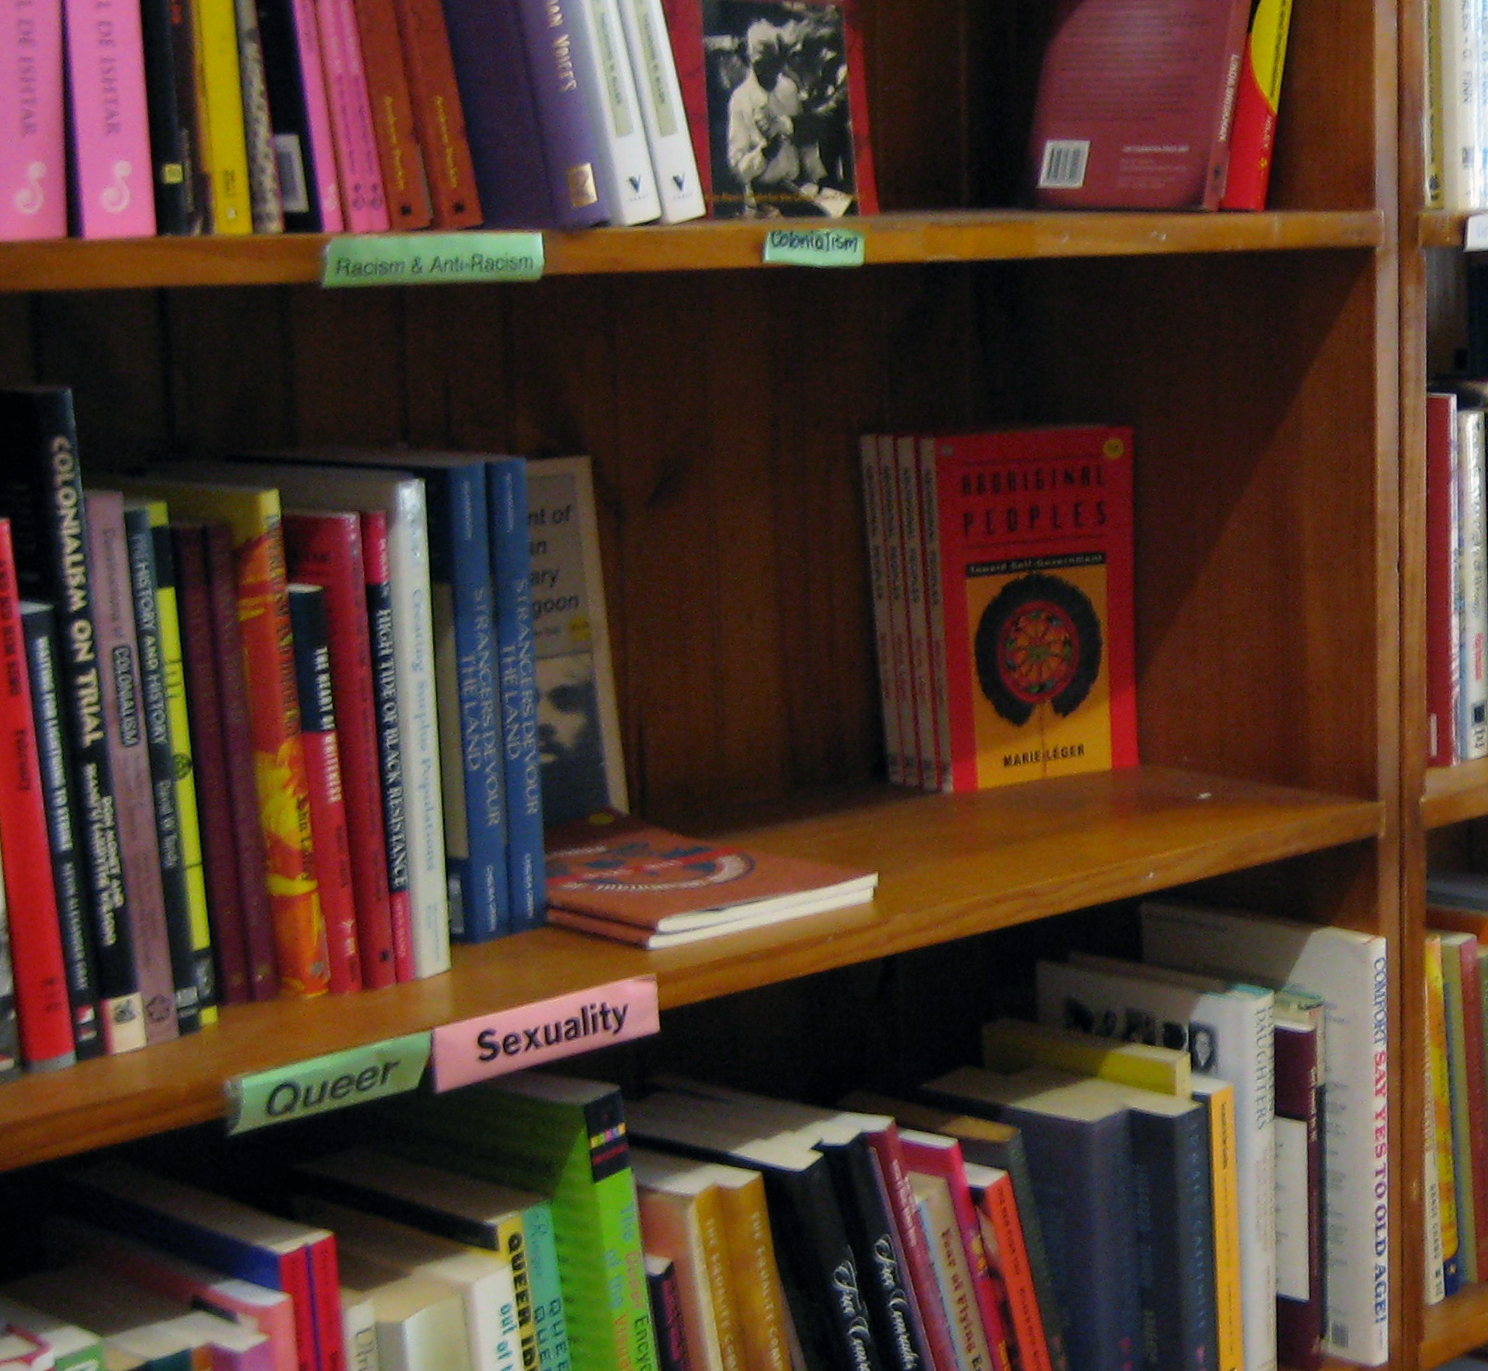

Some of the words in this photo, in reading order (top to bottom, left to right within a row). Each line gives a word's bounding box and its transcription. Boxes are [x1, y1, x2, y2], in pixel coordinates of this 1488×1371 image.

[17, 19, 36, 46] DE
[97, 20, 116, 46] DE
[19, 56, 37, 137] ISHTAR
[100, 57, 122, 136] ISHTAR
[336, 256, 405, 278] Racism
[411, 259, 423, 274] &
[430, 254, 534, 274] Anti-Racism
[770, 229, 859, 253] Colonialism
[961, 464, 1107, 498] ABORIGINAL
[53, 436, 88, 613] COLONIALISM
[552, 504, 573, 526] of
[962, 501, 1107, 537] PEOPLES
[1009, 553, 1105, 572] Self-Government
[70, 619, 94, 663] ON
[144, 636, 159, 673] AND
[313, 646, 330, 671] THE
[376, 608, 394, 653] HIGH
[411, 587, 425, 673] Creating
[474, 587, 493, 727] STRANGERS
[515, 578, 536, 717] STRANGERS
[316, 671, 335, 713] HEART
[379, 655, 397, 700] TIDE
[462, 655, 476, 696] THE
[503, 645, 518, 684] THE
[76, 666, 103, 748] TRIAL
[114, 646, 139, 747] COLONIALISM
[147, 675, 169, 744] HISTORY
[382, 700, 398, 724] OF
[413, 681, 430, 752] Surplus
[504, 690, 522, 760] LAND
[383, 724, 403, 784] BLACK
[463, 701, 481, 771] LAND
[1003, 748, 1042, 769] MARIE
[1044, 743, 1086, 764] LÉGER
[482, 731, 500, 826] DEVOUR
[522, 720, 541, 816] DEVOUR
[385, 785, 408, 888] RESISTANCE
[418, 756, 436, 872] Populations
[1371, 956, 1388, 1047] COMFORT
[477, 1001, 629, 1063] Sexuality
[265, 1054, 400, 1119] Queer
[1254, 1006, 1271, 1131] DAUGHTERS
[1372, 1049, 1388, 1097] SAY
[1372, 1105, 1388, 1160] YES
[1373, 1161, 1388, 1199] TO
[940, 1227, 958, 1268] Fear
[1373, 1202, 1389, 1261] OLD
[508, 1231, 533, 1328] QUEER
[951, 1275, 963, 1293] of
[1373, 1262, 1388, 1325] AGE!
[499, 1301, 518, 1336] out
[956, 1295, 977, 1354] Flying
[496, 1340, 515, 1362] of
